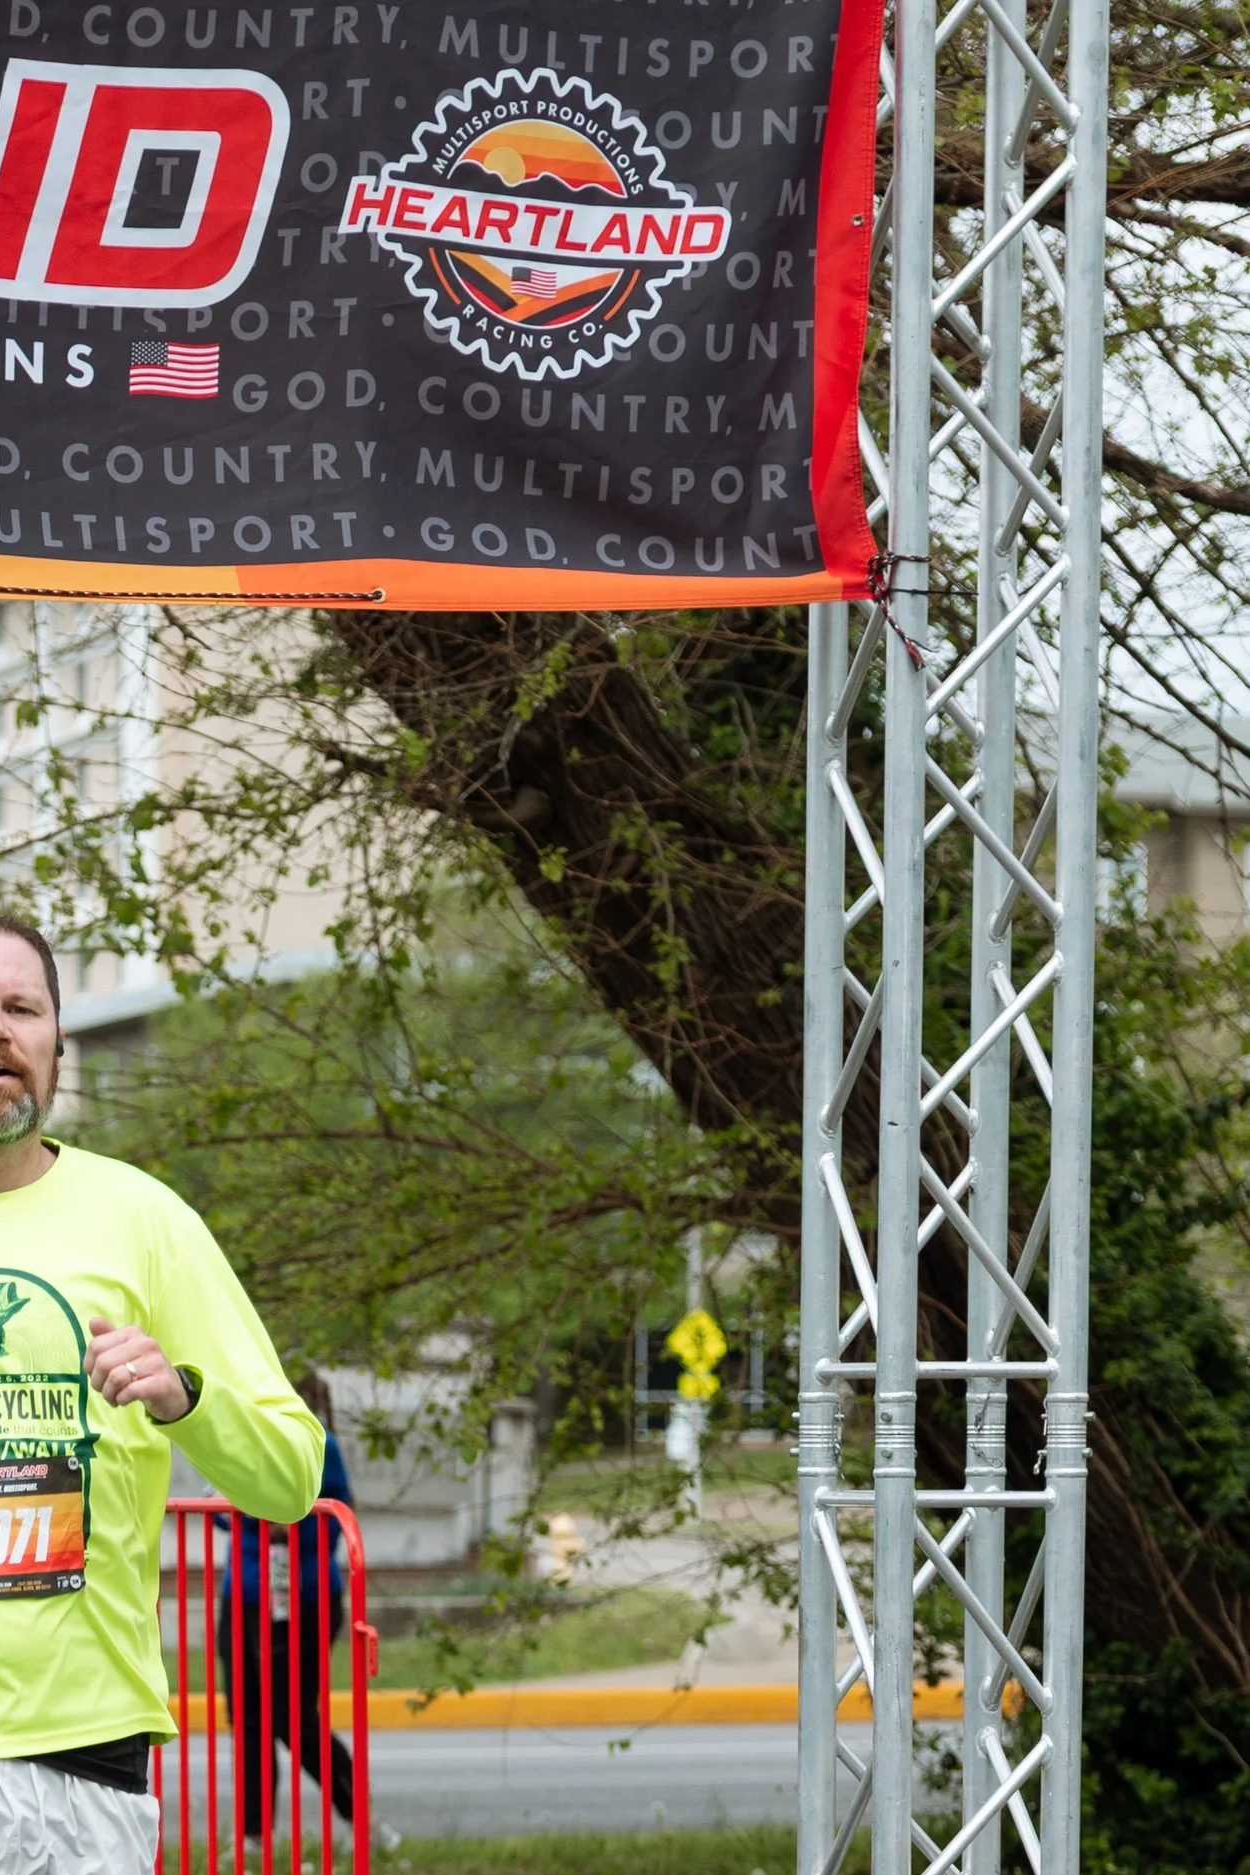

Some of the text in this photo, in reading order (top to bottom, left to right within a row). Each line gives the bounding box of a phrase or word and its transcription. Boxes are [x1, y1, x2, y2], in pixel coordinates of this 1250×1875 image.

[82, 4, 407, 50] COUNTRY,
[432, 101, 644, 196] MULTISPORT PRODUCTIONS
[348, 182, 725, 255] HEARTLAND
[462, 303, 553, 349] RACING
[568, 323, 604, 344] CO.
[233, 368, 386, 413] GOD,
[418, 376, 732, 436] COUNTRY,
[62, 440, 386, 485] COUNTRY,
[20, 1374, 50, 1383] 2022
[13, 1424, 36, 1436] that
[39, 1425, 78, 1437] counts
